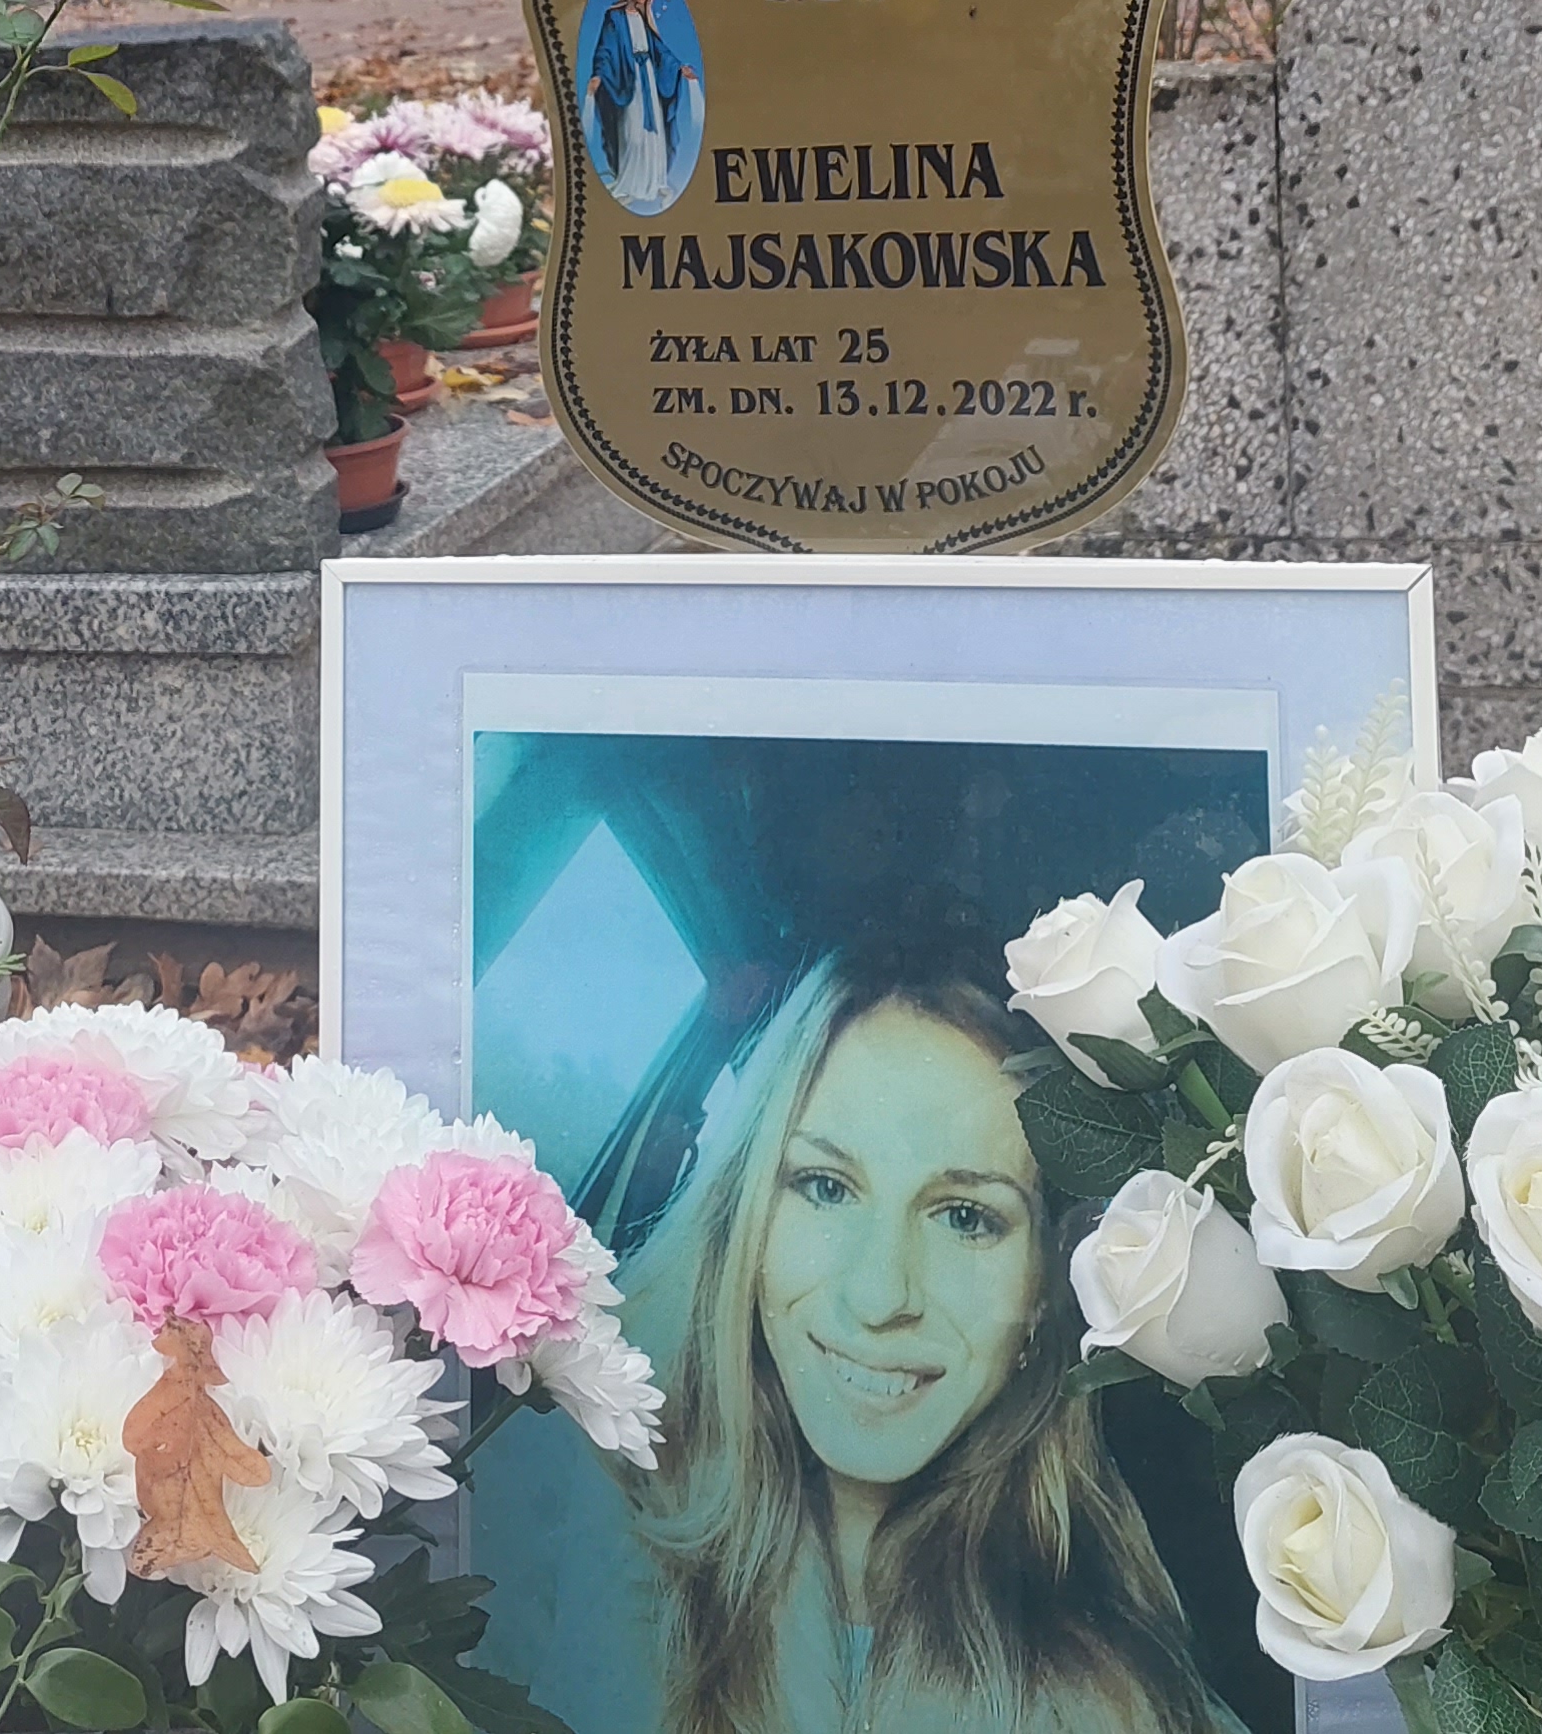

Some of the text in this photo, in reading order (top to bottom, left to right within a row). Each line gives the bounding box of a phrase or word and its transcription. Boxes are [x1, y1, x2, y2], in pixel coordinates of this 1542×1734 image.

[711, 141, 1005, 204] EWELINA
[620, 229, 1106, 290] MAJSAKOWSKA
[649, 327, 890, 364] ŻYŁA LAT 25
[652, 379, 1098, 418] ZM. DN. 13.12.2022 r.
[661, 441, 1047, 515] SPOCZYWAJ W POKOJU
